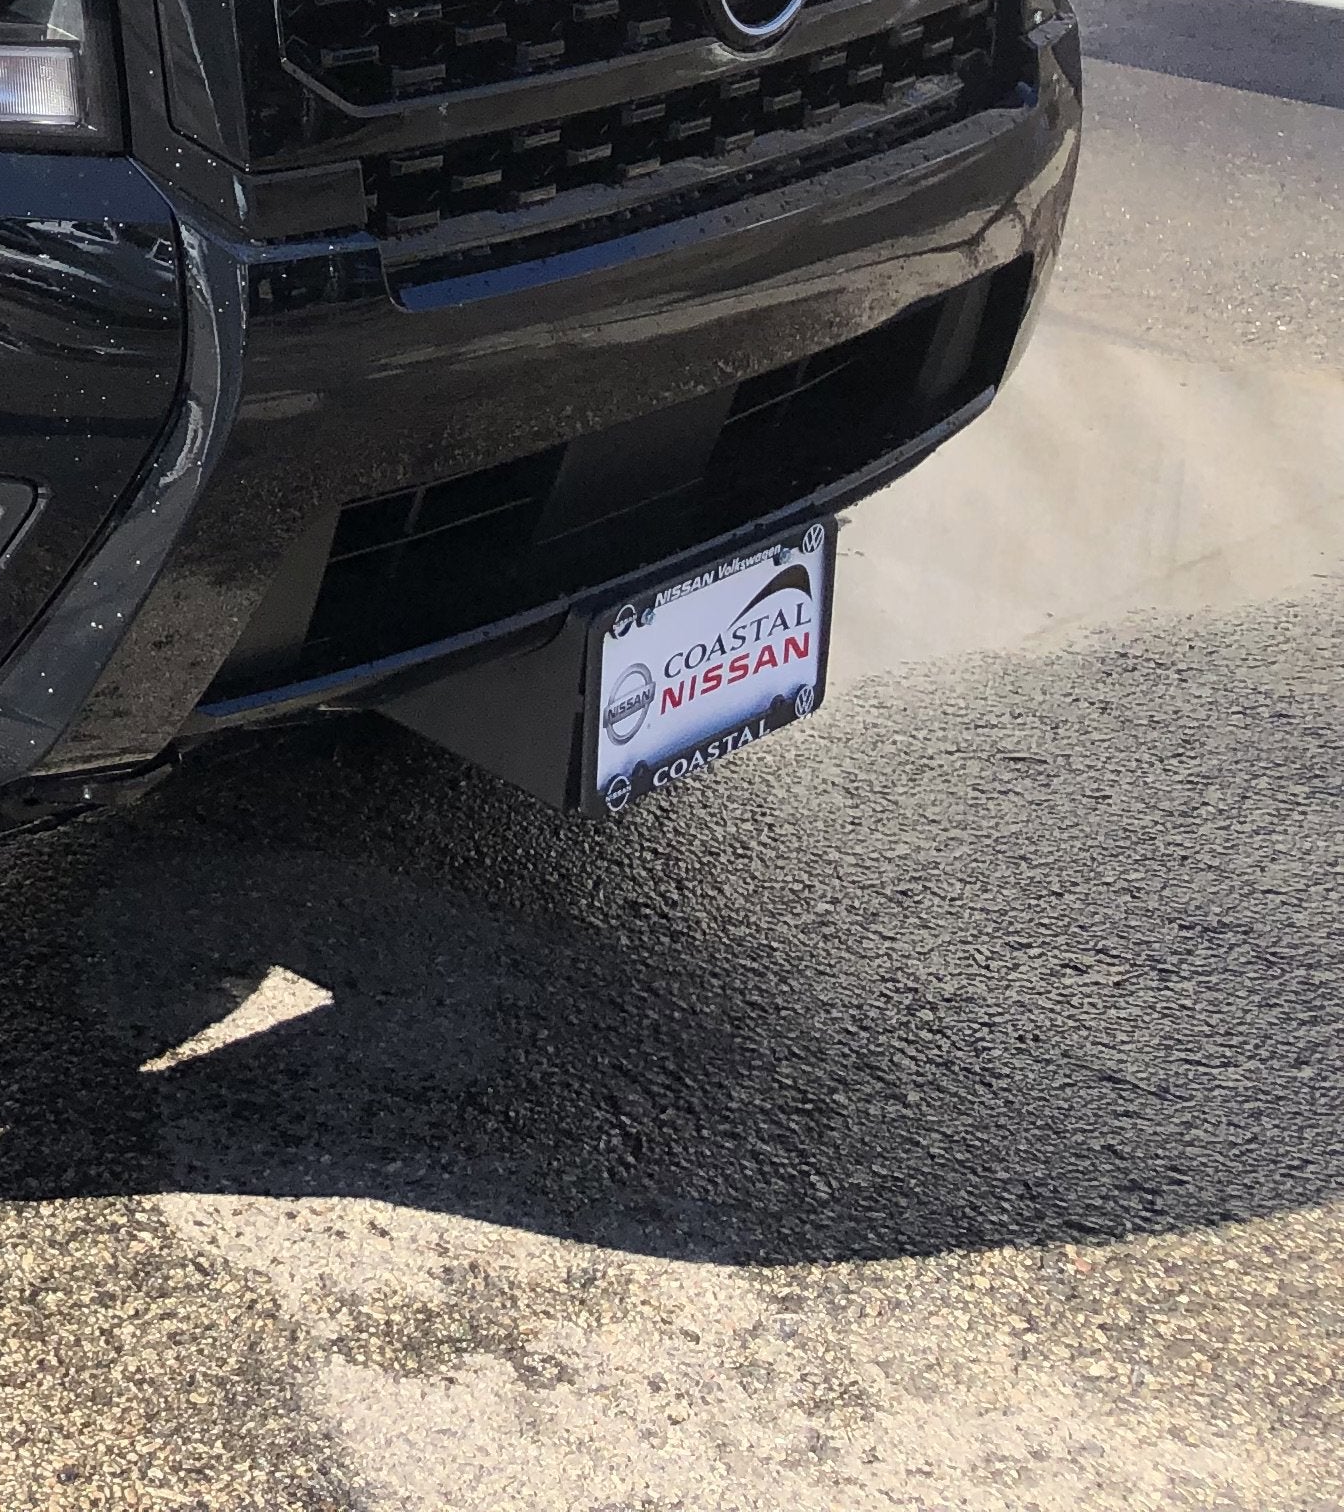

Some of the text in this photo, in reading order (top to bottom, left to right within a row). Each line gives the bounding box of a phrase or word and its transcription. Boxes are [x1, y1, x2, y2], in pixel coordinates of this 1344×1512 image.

[654, 544, 781, 608] NISSAN Volkswagen
[660, 631, 810, 716] NISSAN
[663, 601, 812, 679] COASTAL
[607, 688, 651, 721] NISSAN
[653, 718, 771, 787] COASTAL
